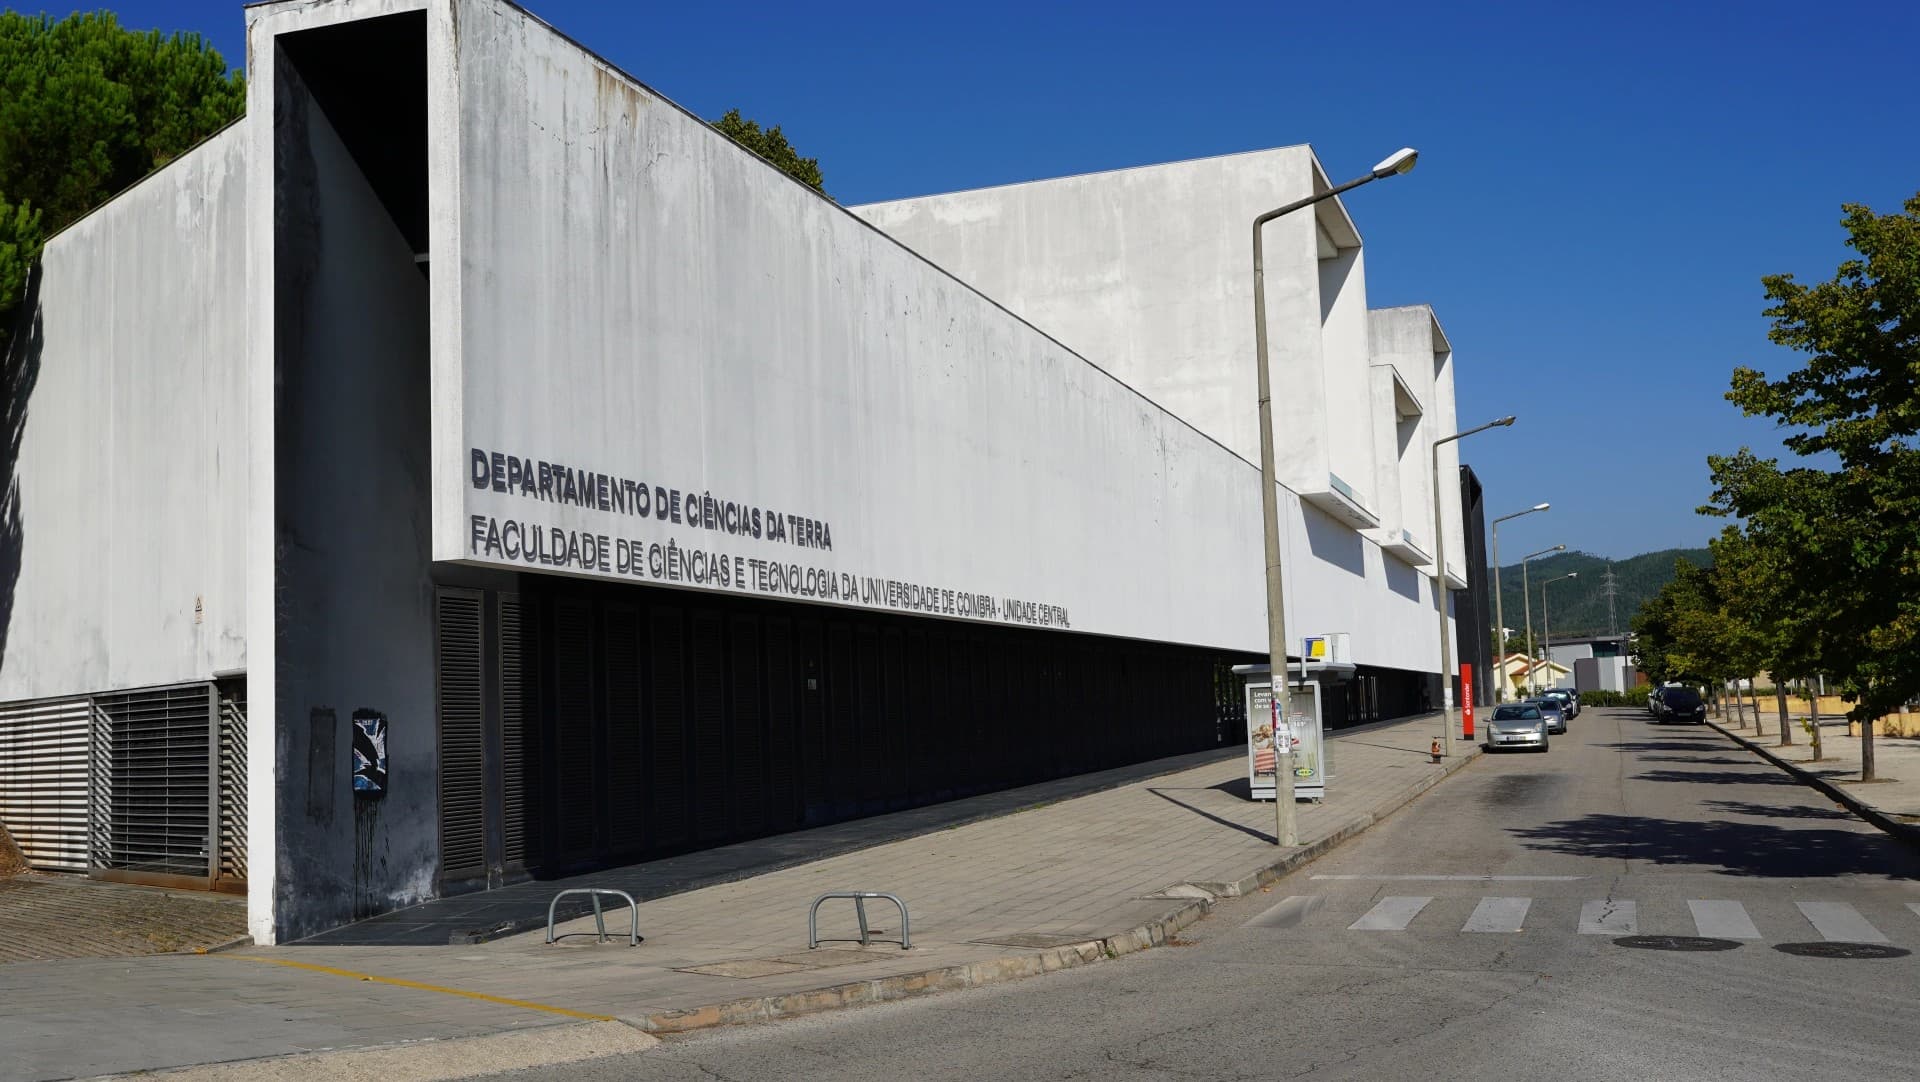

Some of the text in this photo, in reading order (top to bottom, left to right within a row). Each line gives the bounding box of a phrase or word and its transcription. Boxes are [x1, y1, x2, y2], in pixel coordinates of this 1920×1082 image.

[471, 447, 832, 551] DEPARTAMENTO DE CIÊNCIAS DA TERRA
[470, 514, 611, 573] FACULDADE
[616, 538, 644, 577] DE
[649, 537, 730, 587] CIÊNCIAS
[735, 556, 746, 590] E
[749, 558, 839, 601] TECNOLOGIA
[841, 572, 859, 601] DA
[861, 576, 940, 613] UNIVERSIDADE
[942, 588, 955, 615] DE
[957, 591, 997, 618] COIMBRA
[1002, 598, 1038, 625] UNIDADE
[1038, 604, 1071, 628] CENTRAL
